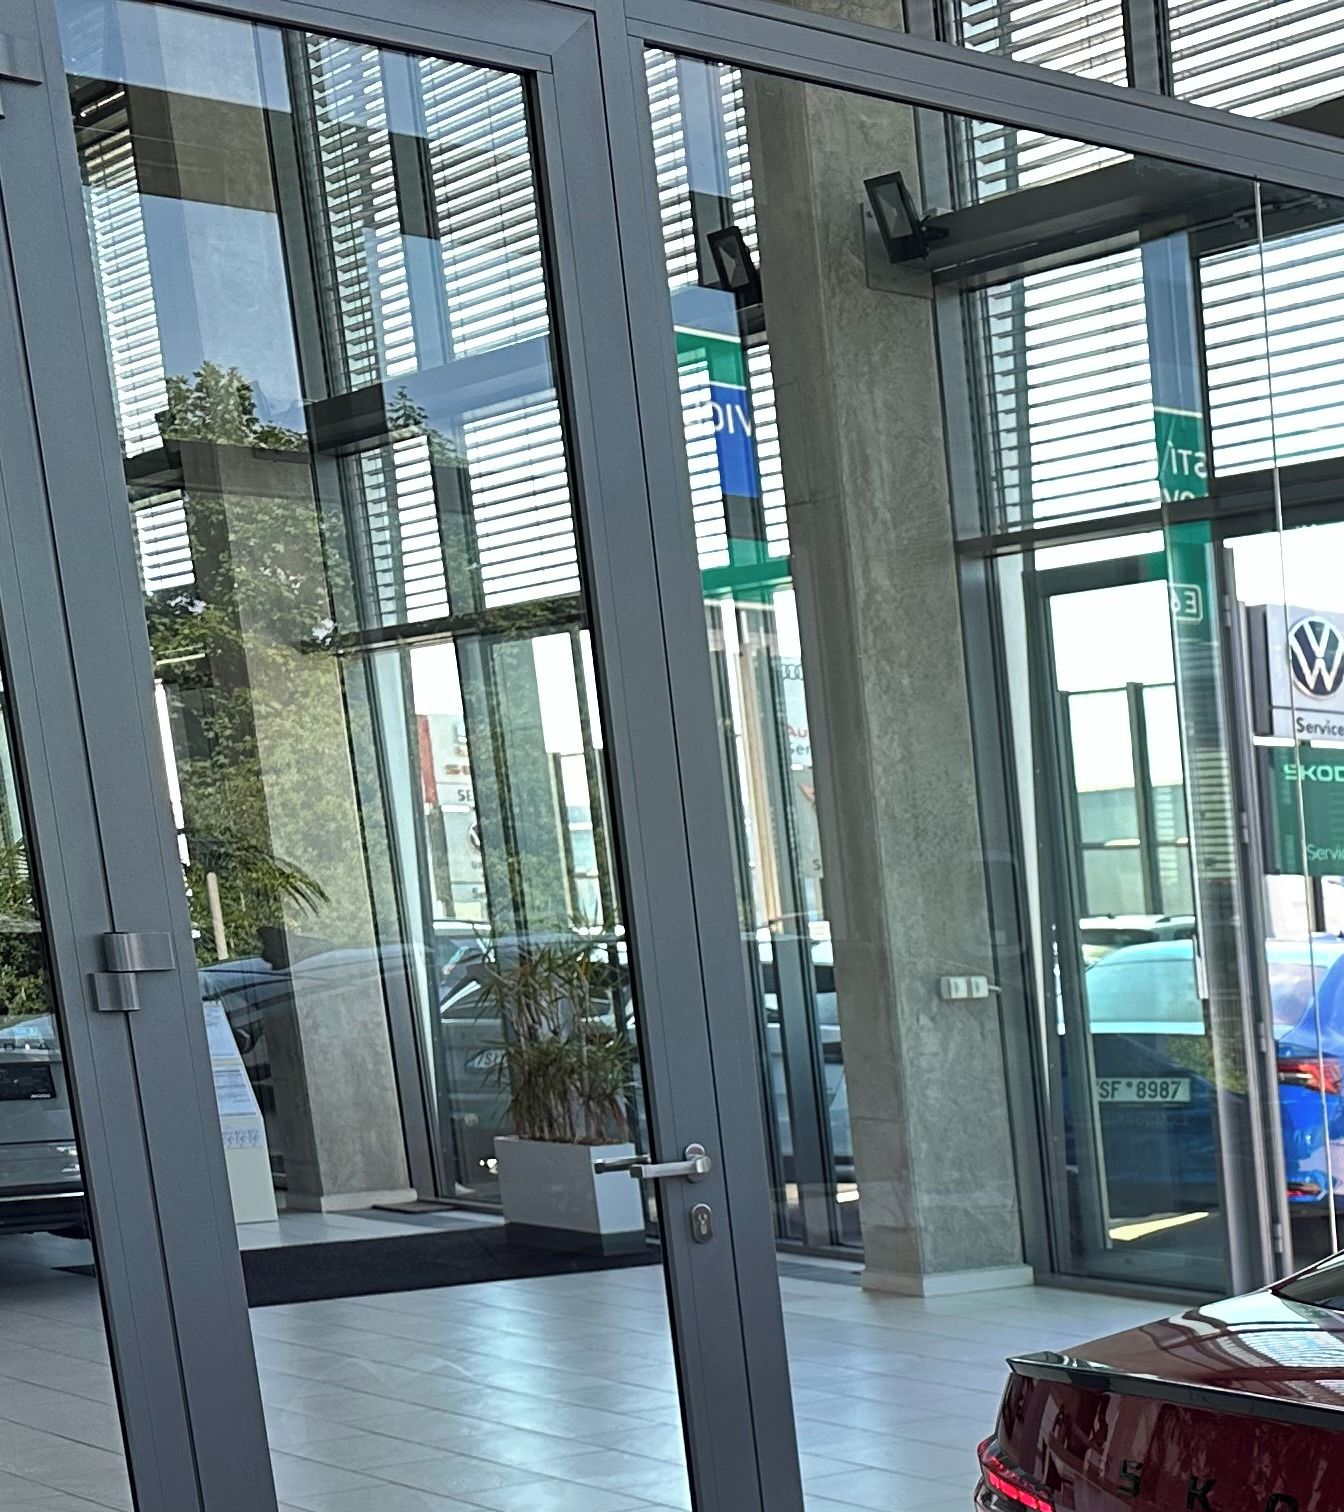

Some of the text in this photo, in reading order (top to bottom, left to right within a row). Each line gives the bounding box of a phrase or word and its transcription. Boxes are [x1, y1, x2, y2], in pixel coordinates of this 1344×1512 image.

[1296, 717, 1344, 737] Service
[1097, 1080, 1181, 1099] SF 8987
